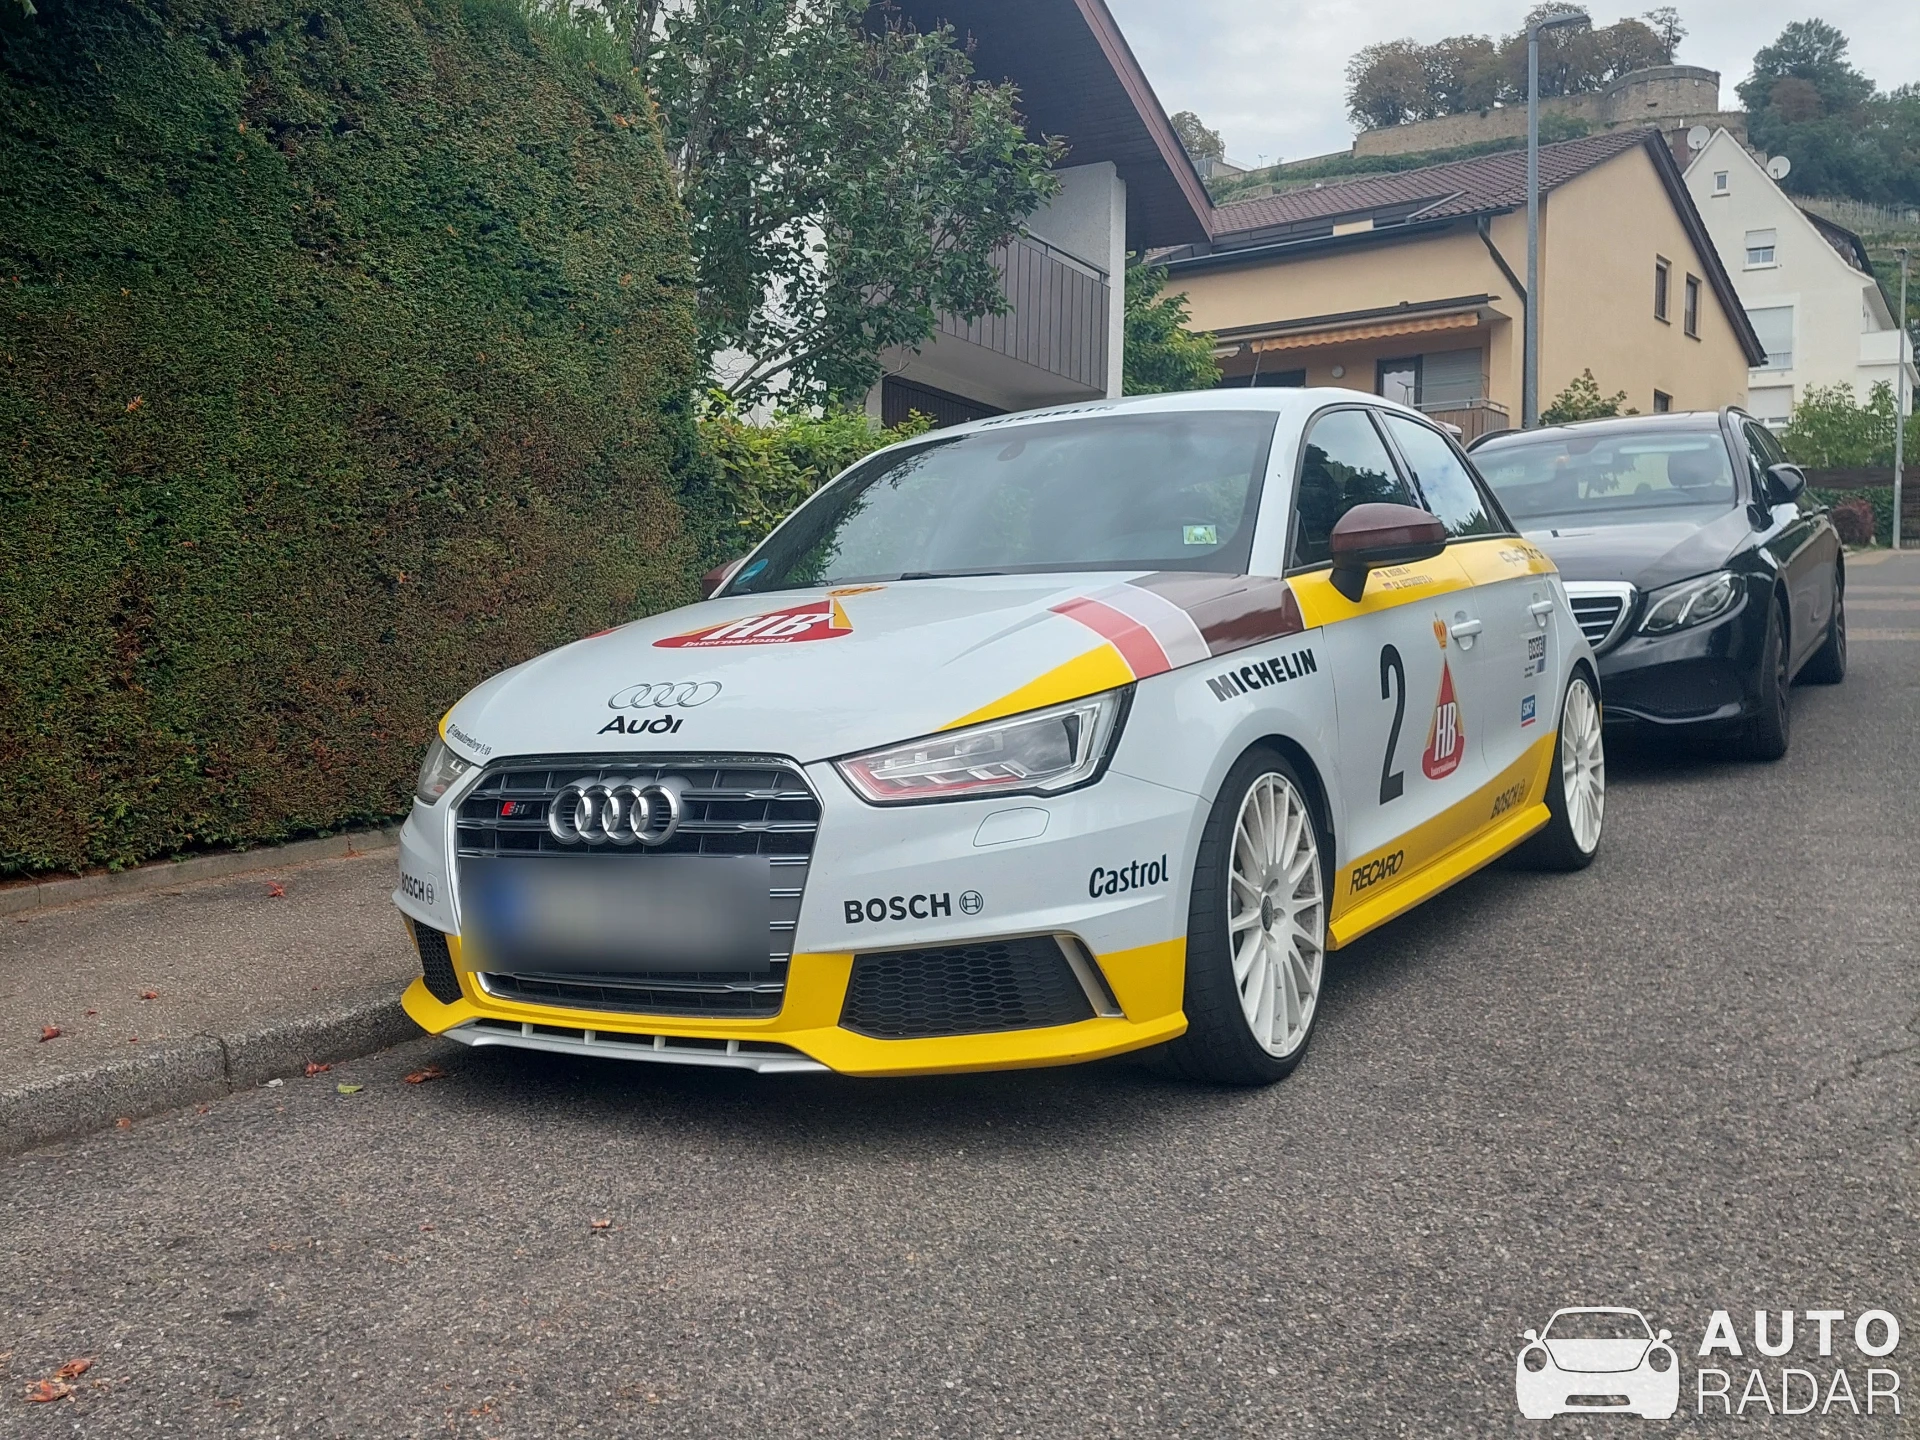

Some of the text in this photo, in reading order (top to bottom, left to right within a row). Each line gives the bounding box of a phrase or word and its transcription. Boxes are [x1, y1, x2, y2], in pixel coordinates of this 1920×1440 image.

[681, 636, 793, 648] International
[700, 613, 836, 641] HB
[1205, 648, 1317, 702] MICHELIN
[597, 714, 684, 735] Audi
[1379, 643, 1406, 806] 2
[1522, 700, 1535, 717] SKF
[1433, 701, 1457, 762] HB
[1490, 782, 1520, 820] BOSCH
[401, 871, 425, 902] BOSCH
[1089, 853, 1169, 899] Castrol
[1350, 850, 1404, 896] RECARO
[844, 892, 951, 924] BOSCH
